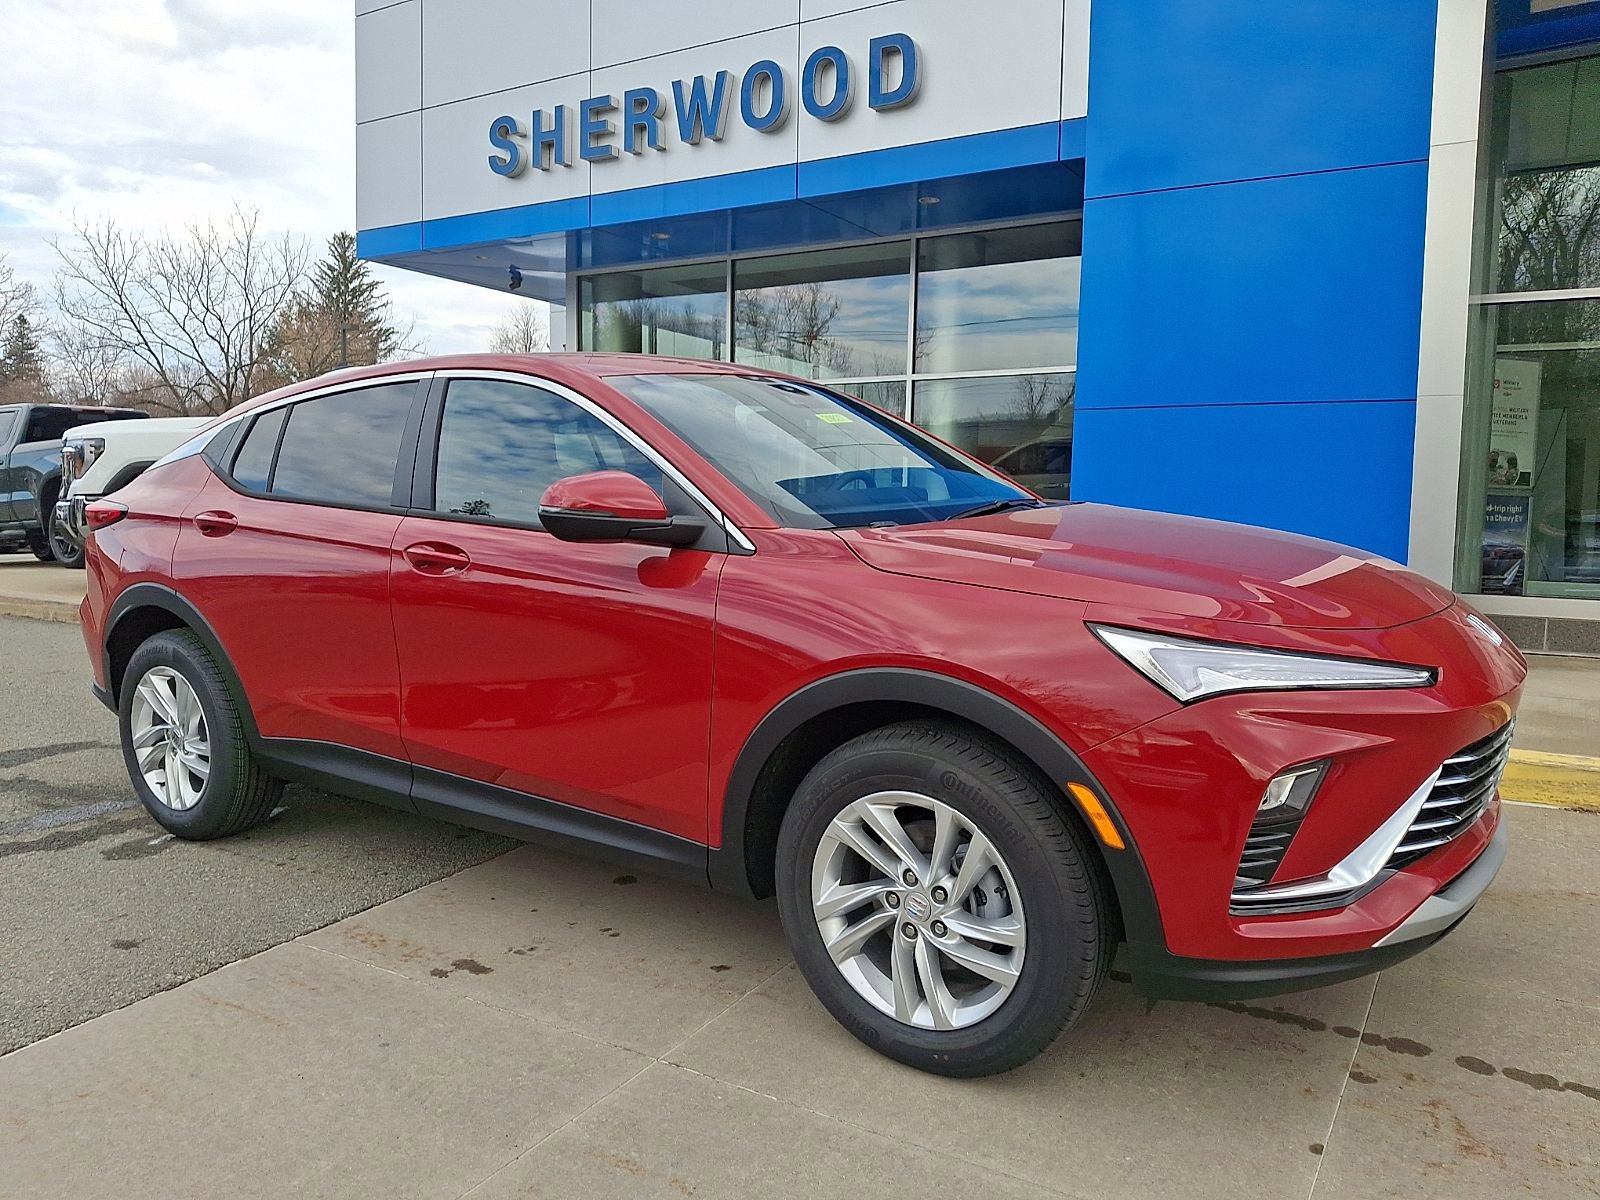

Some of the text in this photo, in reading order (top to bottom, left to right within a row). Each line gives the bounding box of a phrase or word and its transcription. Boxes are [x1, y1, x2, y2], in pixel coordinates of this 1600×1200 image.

[488, 32, 923, 179] SHERWOOD
[1486, 504, 1522, 514] d-trip right
[1494, 514, 1514, 523] Chevy
